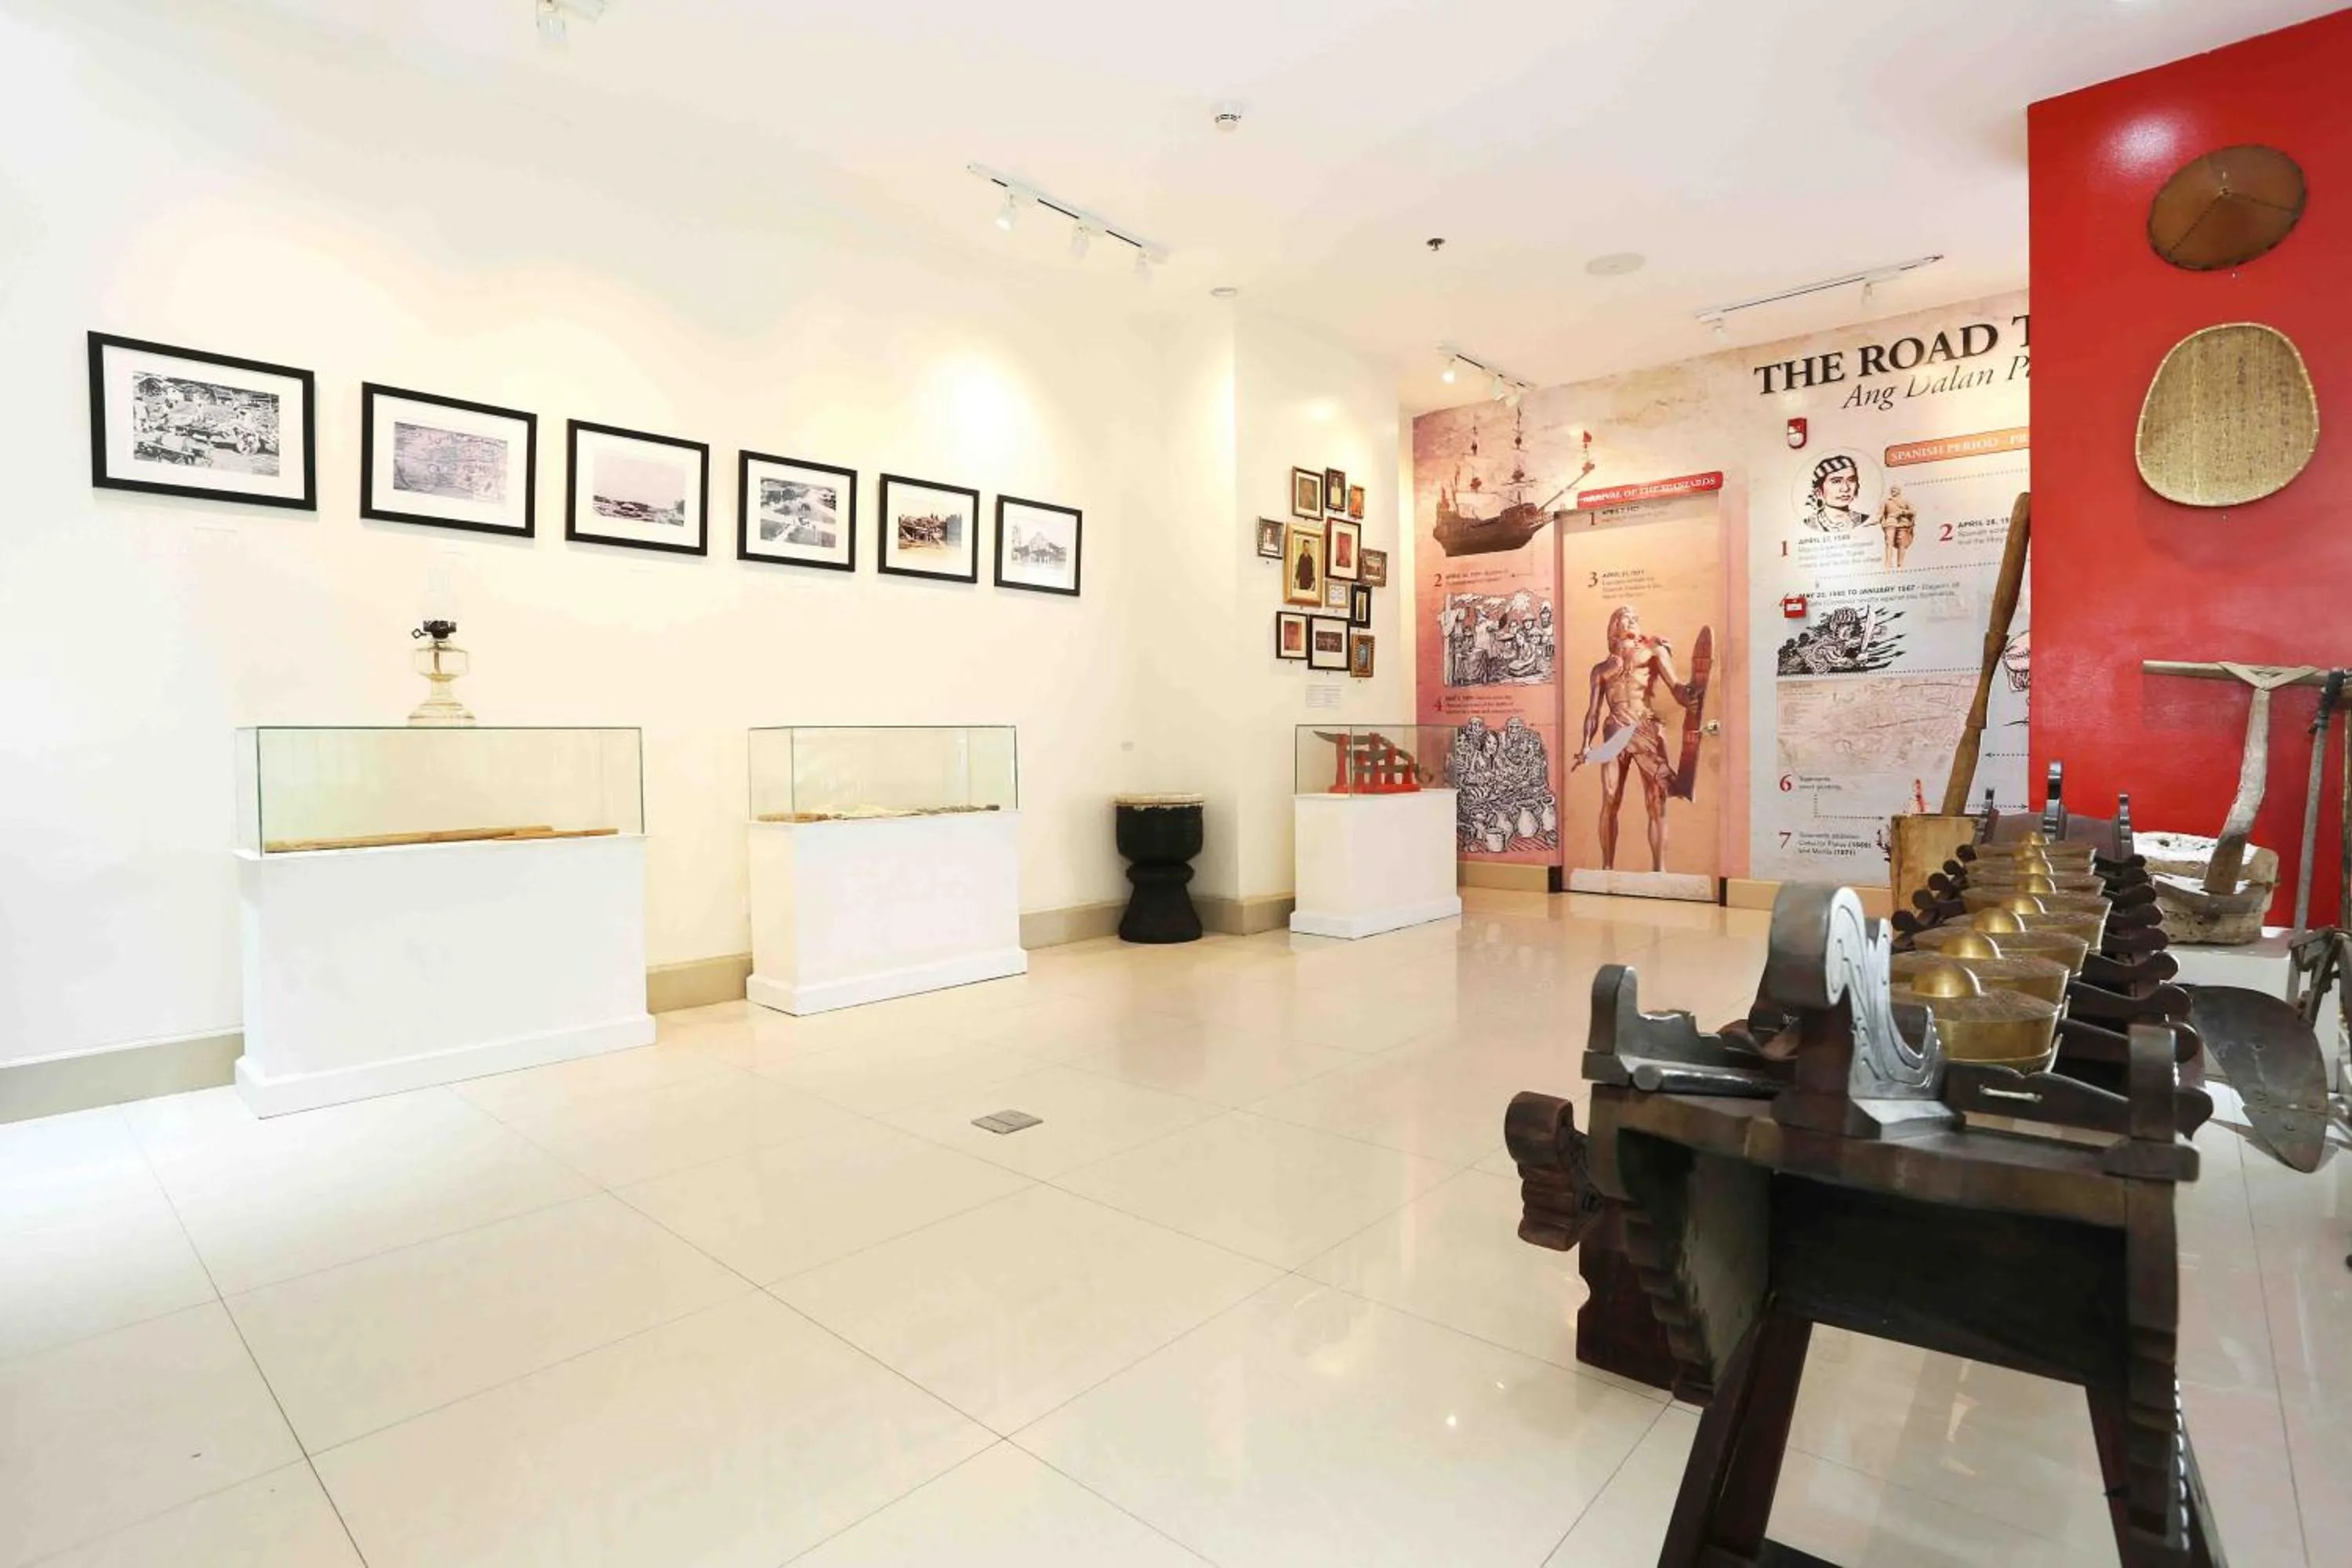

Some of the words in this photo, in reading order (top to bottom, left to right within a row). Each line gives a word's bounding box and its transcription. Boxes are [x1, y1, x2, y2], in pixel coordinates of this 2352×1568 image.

[1754, 351, 1845, 395] THE
[1857, 324, 1999, 377] ROAD
[2011, 314, 2030, 347] T
[1842, 383, 1896, 411] Ang
[1904, 365, 1994, 399] Dalan
[2007, 355, 2030, 380] P
[1891, 446, 1945, 461] SPANISH
[1947, 437, 1998, 453] PERIOD
[1590, 511, 1596, 526] 1
[1939, 523, 1954, 542] 2
[1780, 540, 1788, 557] 1
[1434, 573, 1443, 587] 2
[1588, 571, 1599, 588] 3
[1859, 586, 1895, 595] JANUARY
[1780, 774, 1791, 793] 6
[1779, 831, 1792, 850] 7
